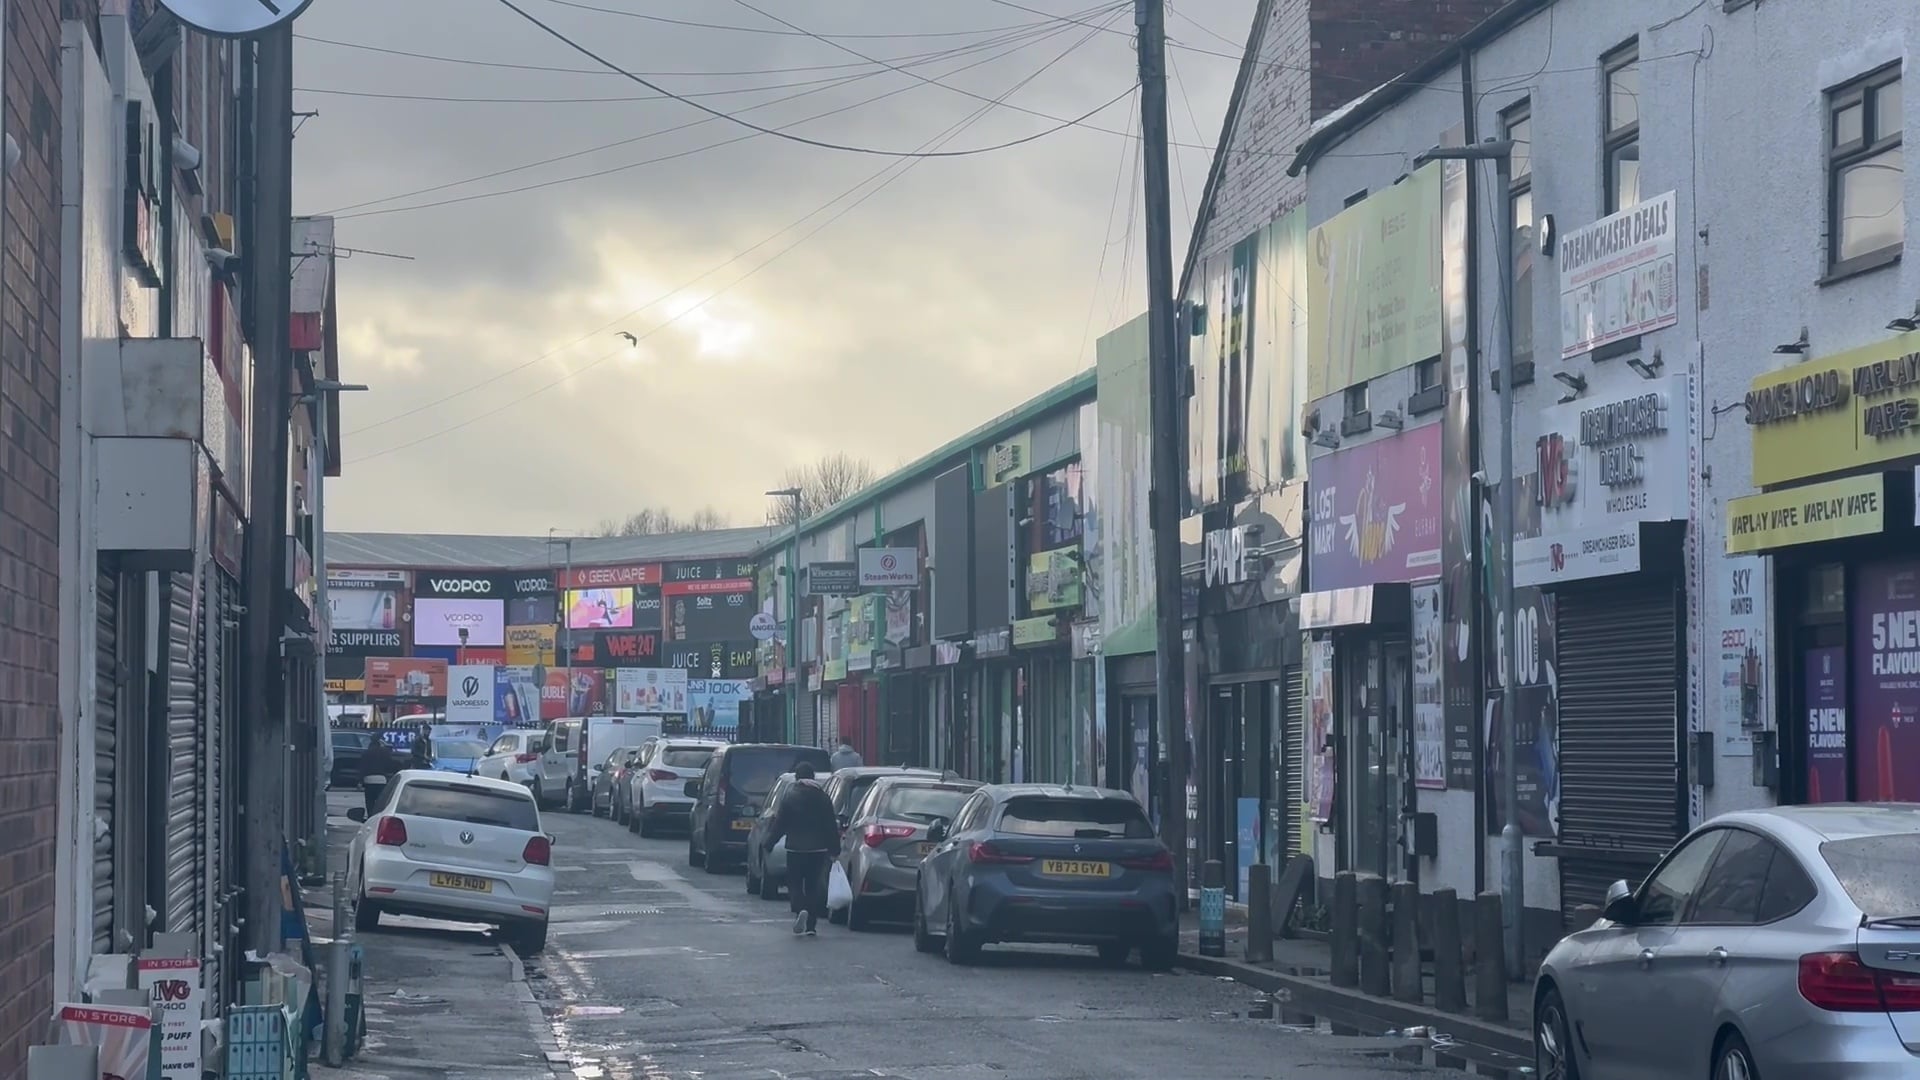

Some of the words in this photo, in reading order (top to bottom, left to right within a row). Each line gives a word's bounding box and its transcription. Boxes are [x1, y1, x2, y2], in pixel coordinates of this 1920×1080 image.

[1562, 214, 1631, 273] DREAMCHASER
[1634, 200, 1668, 244] DEALS
[1745, 382, 1792, 424] SMOKE
[1580, 392, 1661, 446] DREAMCHASER
[1864, 399, 1909, 437] VAPE
[1600, 443, 1638, 486] DEALS
[1314, 486, 1336, 521] LOST
[1606, 493, 1647, 513] WHOLESALE
[1732, 511, 1768, 536] VAPLAY
[1771, 507, 1798, 529] VAPE
[1804, 497, 1844, 524] VAPLAY
[1847, 492, 1877, 516] VAPE
[1314, 522, 1336, 555] MARY
[1582, 538, 1618, 554] DREAMCHASER
[1619, 532, 1635, 548] DEALS
[588, 567, 646, 584] GEEKVAPE
[676, 566, 701, 579] JUICE
[1732, 568, 1752, 596] SKY
[430, 578, 491, 593] VOOPOO
[514, 577, 547, 593] VOOPOO
[1730, 597, 1753, 616] HUNTER
[444, 613, 483, 622] VOOPOO
[340, 632, 400, 646] SUPPLIERS
[1722, 629, 1745, 648] 2600
[1872, 613, 1886, 650] 5
[606, 635, 637, 656] VAPE
[638, 634, 655, 655] 247
[672, 653, 699, 668] JUICE
[1873, 651, 1920, 675] FLAVOU
[688, 680, 705, 690] JNR
[709, 682, 740, 694] 100K
[1809, 709, 1818, 732] 5
[1047, 860, 1078, 872] YB73
[1081, 862, 1104, 875] GYA
[437, 873, 462, 887] LY15
[153, 979, 191, 1001] IVG
[74, 1009, 89, 1020] IN
[91, 1012, 137, 1025] STORE
[167, 1032, 192, 1041] PUFF
